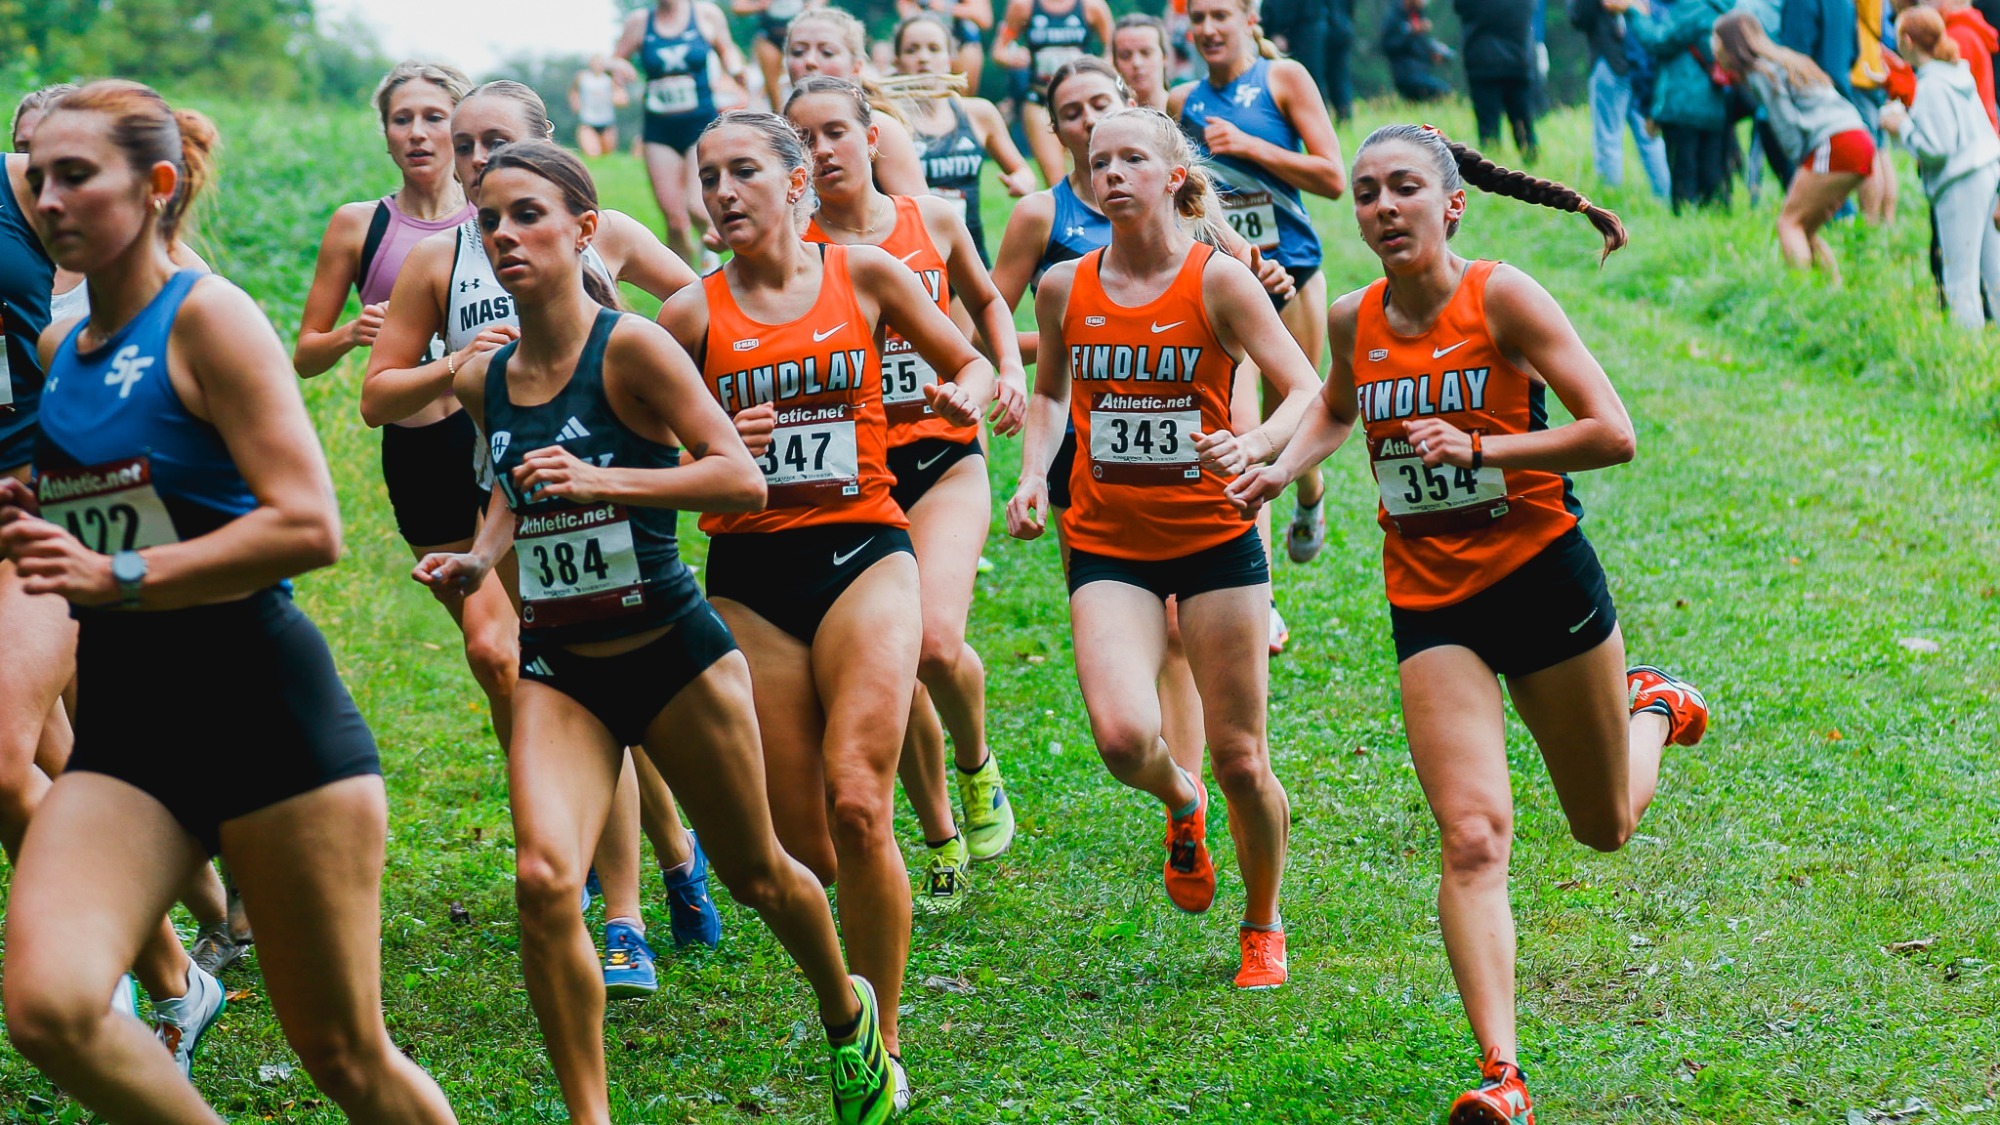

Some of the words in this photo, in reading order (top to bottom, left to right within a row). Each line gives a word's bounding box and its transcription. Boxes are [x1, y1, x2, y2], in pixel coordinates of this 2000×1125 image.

[1228, 211, 1263, 239] 28
[104, 344, 155, 399] SF
[717, 349, 866, 412] FINDLAY
[881, 359, 918, 397] 55
[1071, 344, 1203, 383] FINDLAY
[1098, 392, 1192, 410] Athletic.net
[1357, 366, 1491, 423] FINDLAY
[774, 405, 844, 425] letic.net
[759, 431, 832, 475] 347
[1110, 418, 1179, 455] 343
[39, 463, 142, 502] Athletic.net
[1398, 463, 1479, 504] 354
[518, 504, 615, 536] Athletic.net
[533, 537, 609, 588] 384
